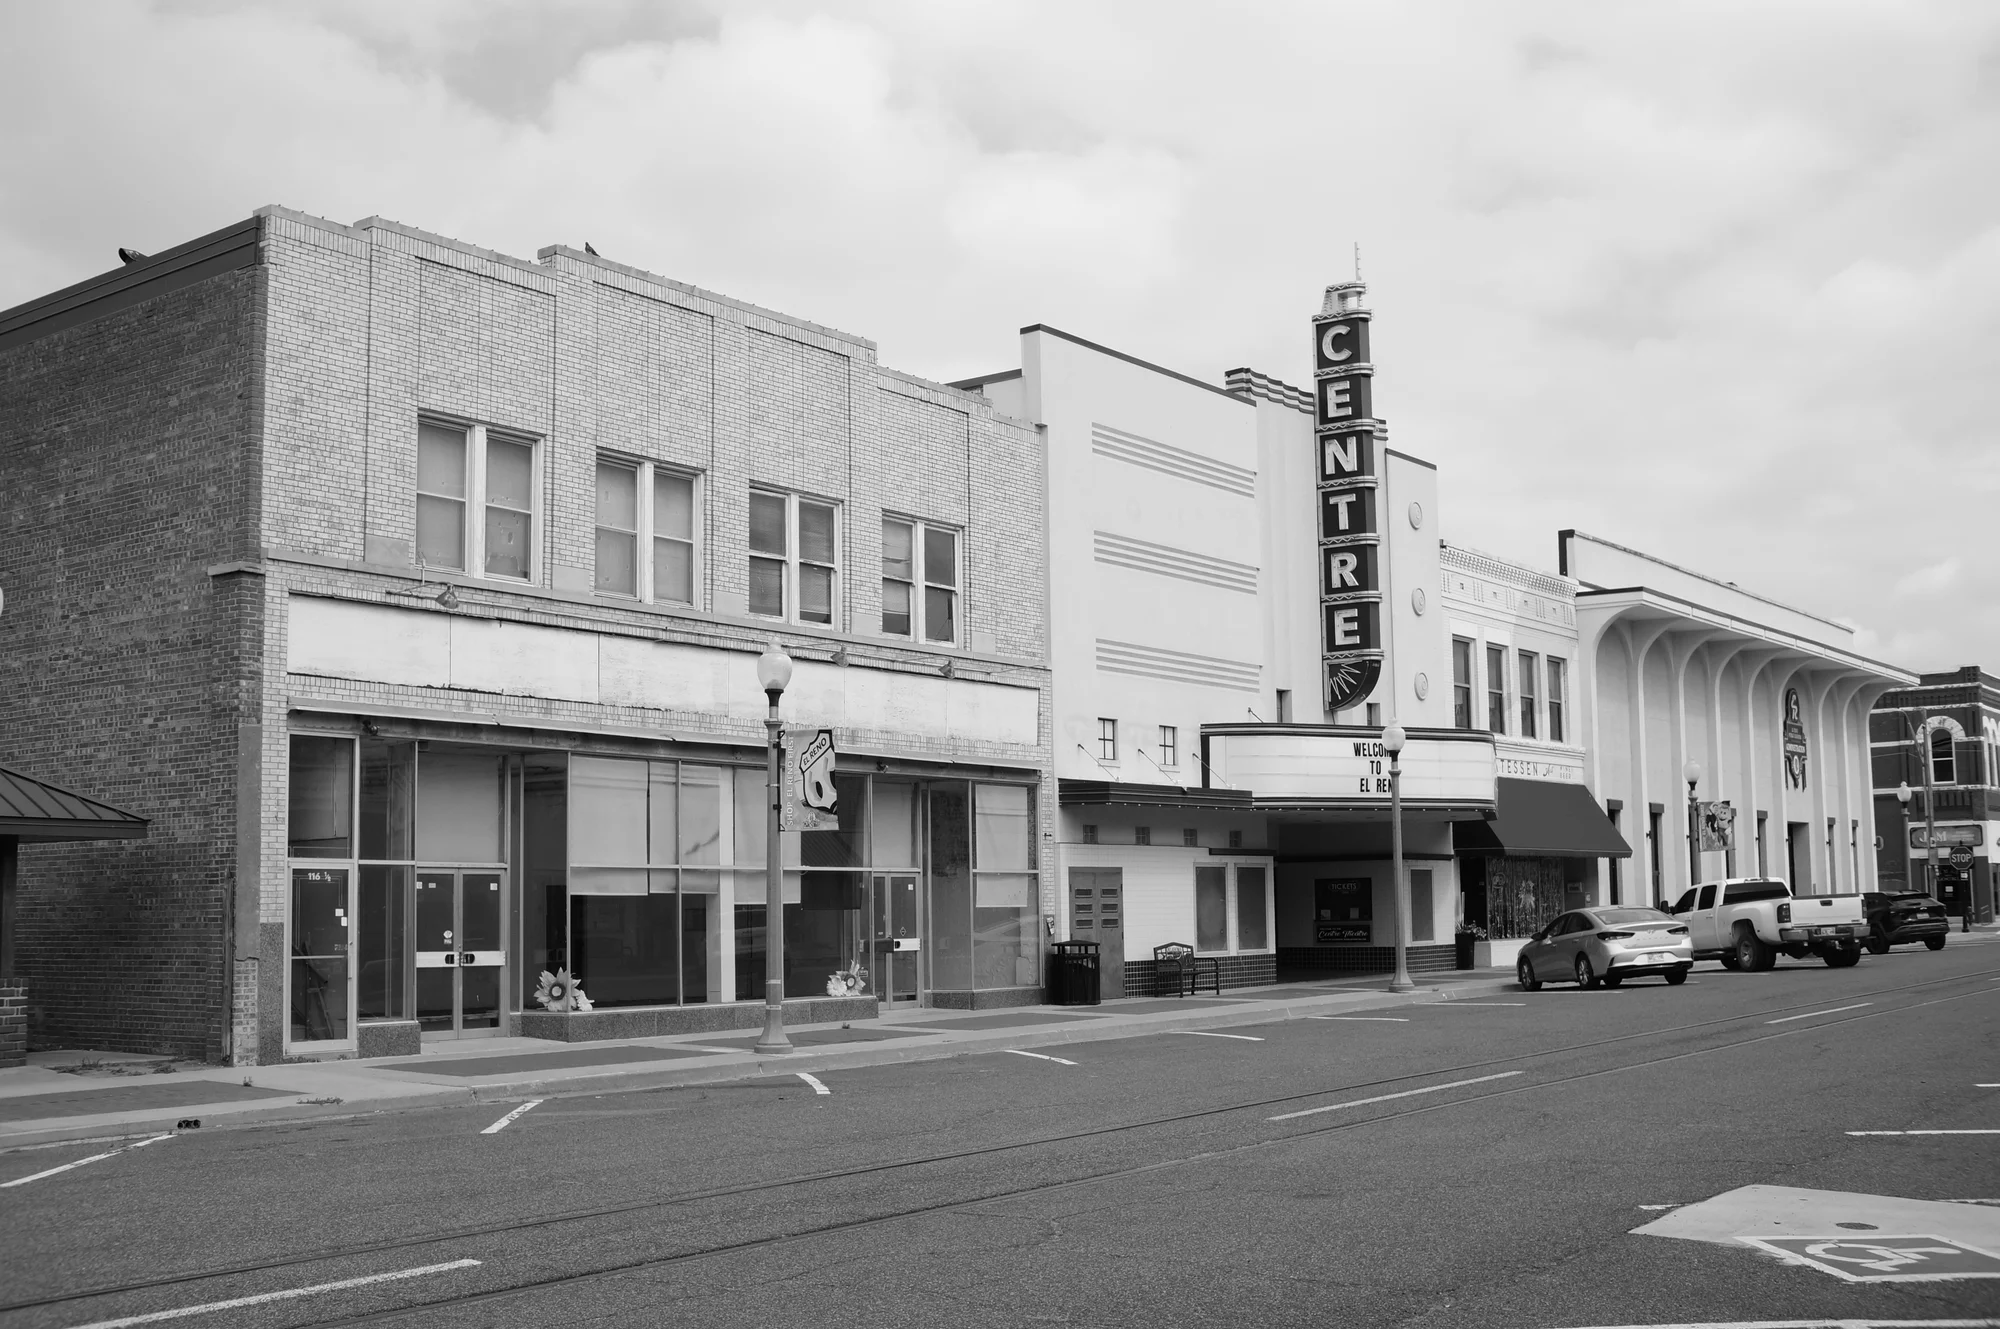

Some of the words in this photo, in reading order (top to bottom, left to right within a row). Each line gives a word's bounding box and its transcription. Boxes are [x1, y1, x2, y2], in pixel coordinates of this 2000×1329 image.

[1322, 324, 1360, 646] CENTRE
[803, 756, 810, 766] EL
[809, 737, 827, 759] RENO
[786, 761, 794, 785] RENO
[1370, 760, 1381, 775] TO
[786, 787, 793, 797] EL
[1360, 778, 1370, 793] EL
[1376, 778, 1392, 793] REN
[786, 802, 794, 826] SHOP
[1951, 853, 1972, 863] STOP
[308, 872, 320, 880] 116
